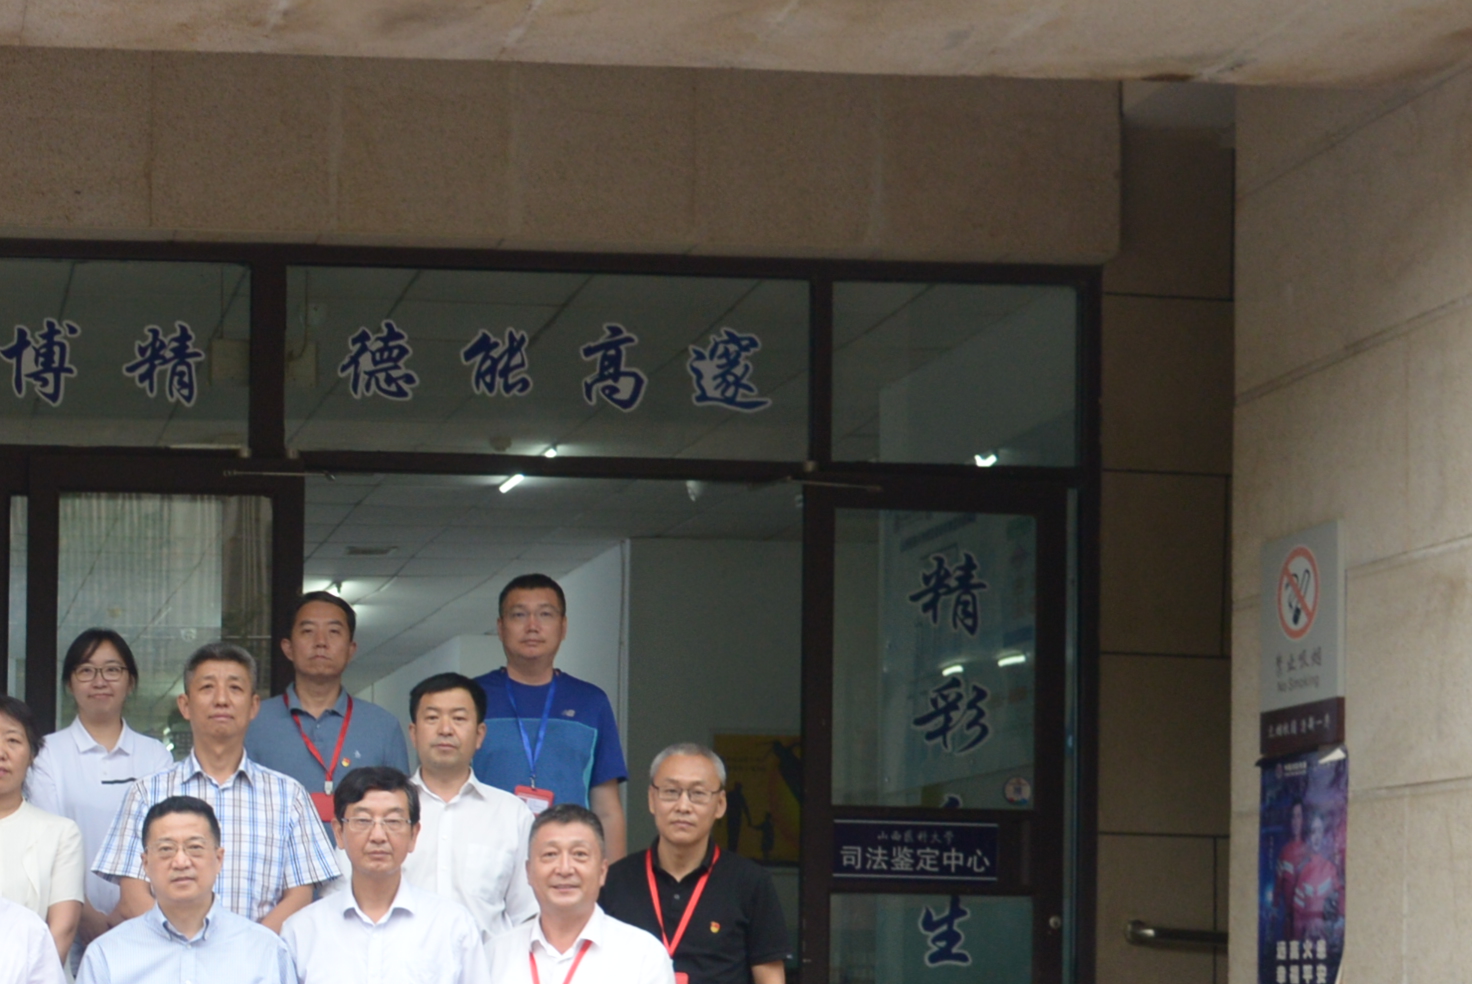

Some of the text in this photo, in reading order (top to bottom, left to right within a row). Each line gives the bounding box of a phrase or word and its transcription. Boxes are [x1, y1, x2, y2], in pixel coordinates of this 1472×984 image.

[840, 846, 991, 873] 司法鉴定中心
